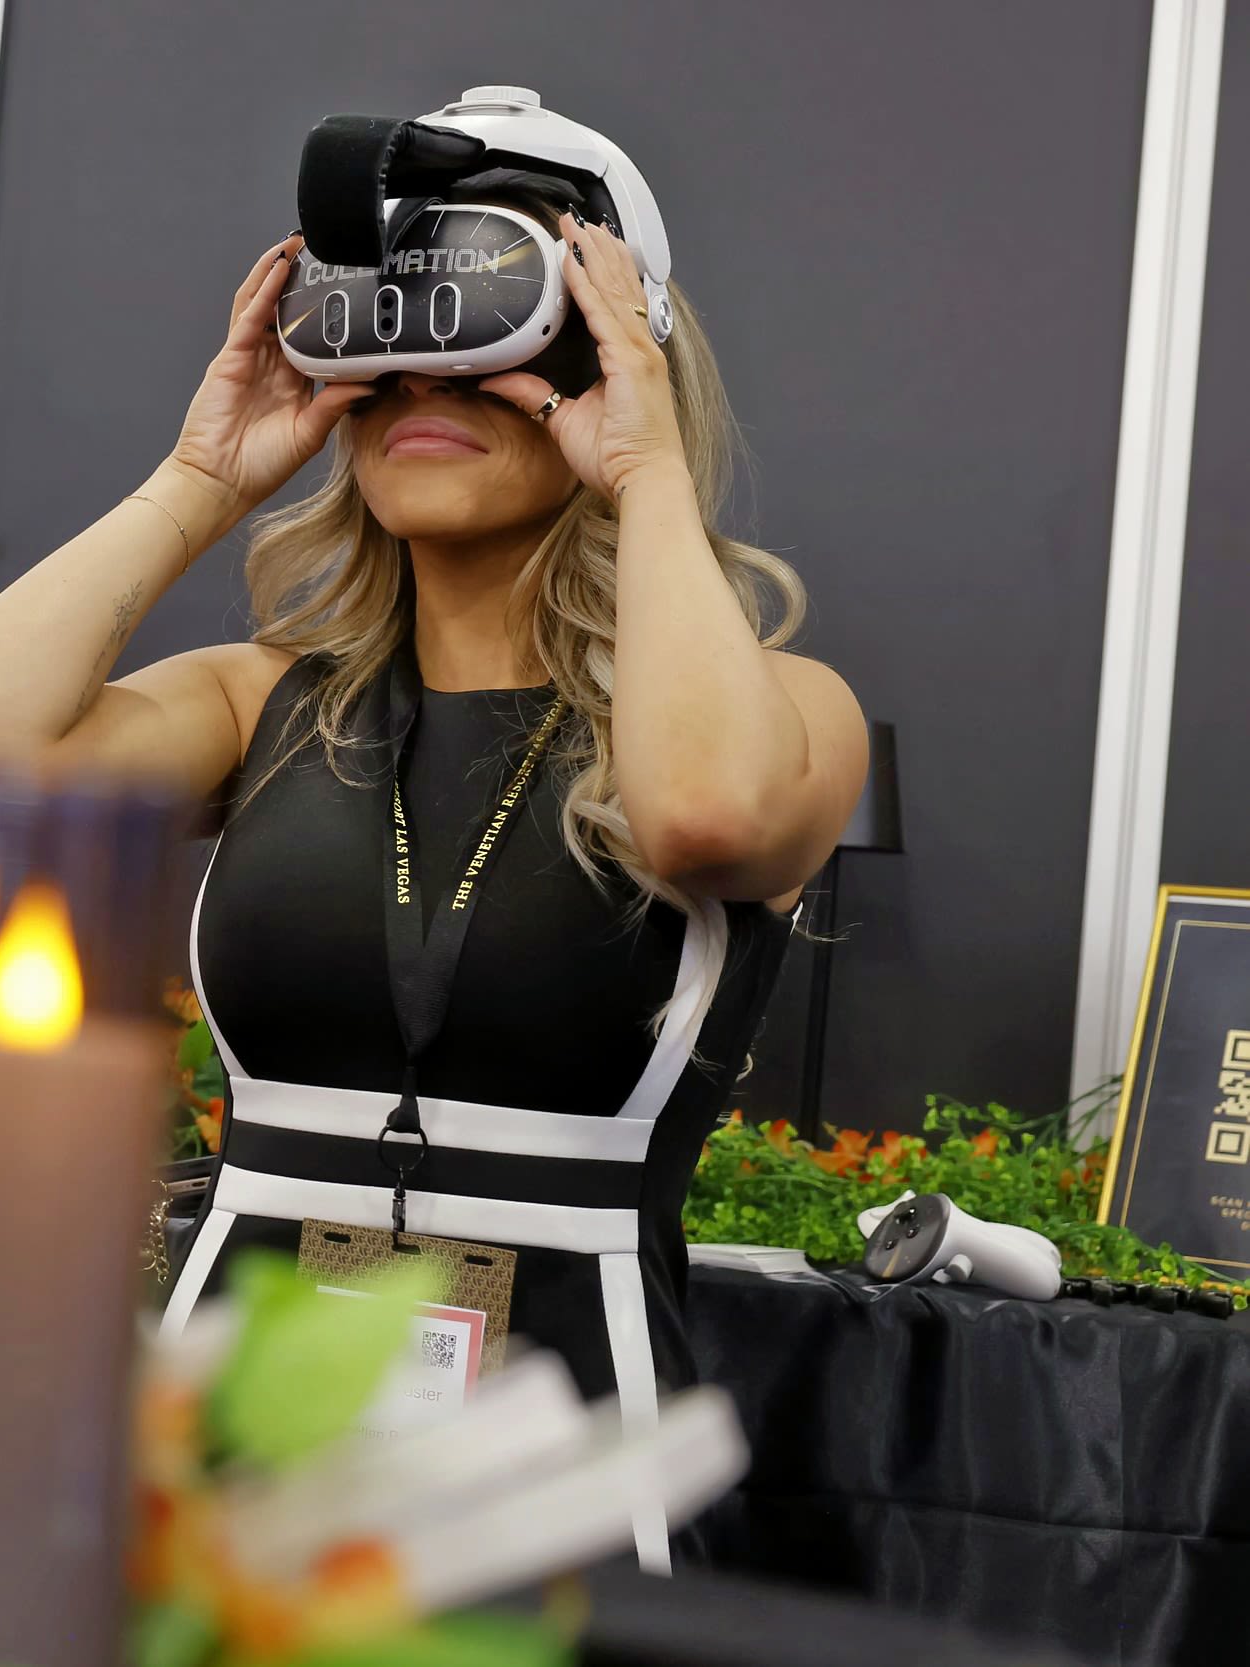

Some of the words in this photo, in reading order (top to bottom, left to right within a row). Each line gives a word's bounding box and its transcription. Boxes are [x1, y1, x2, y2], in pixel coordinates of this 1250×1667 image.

[305, 248, 500, 286] COLMATION
[396, 828, 408, 854] LAS
[452, 880, 474, 911] THE
[465, 810, 509, 878] VENETIAN
[396, 858, 410, 904] VEGAS
